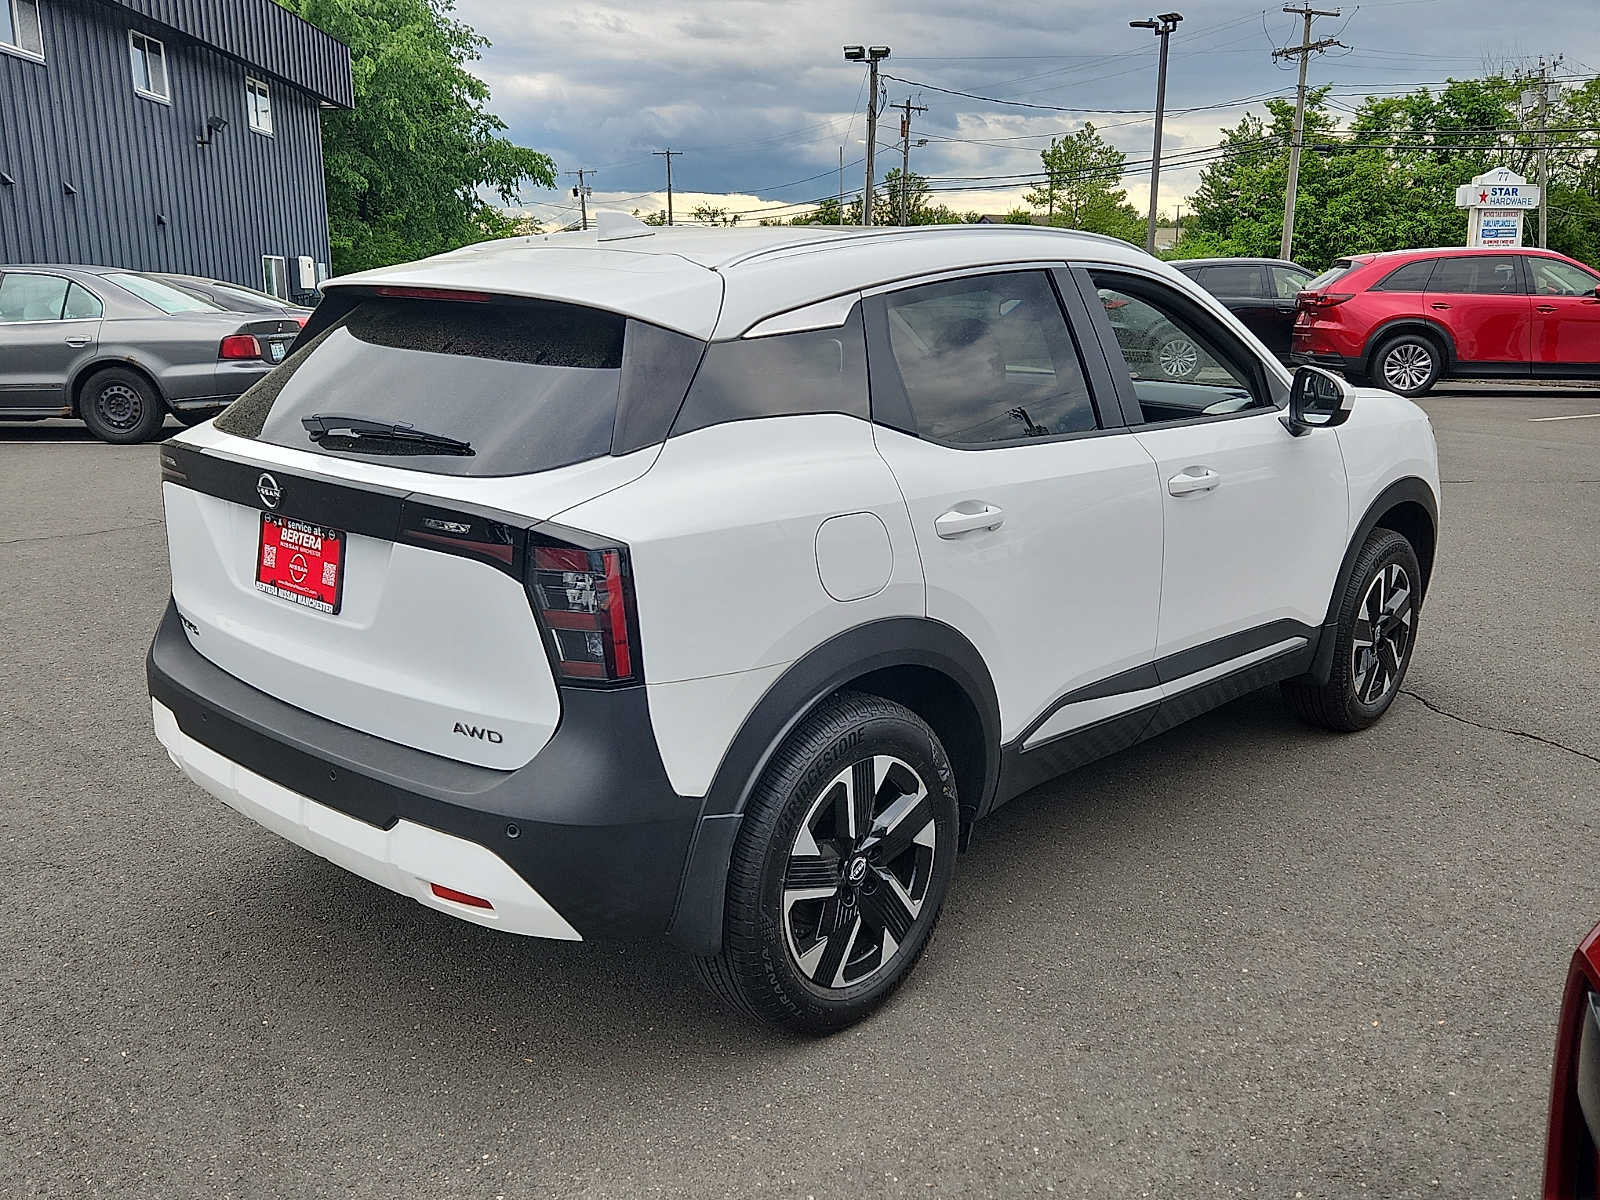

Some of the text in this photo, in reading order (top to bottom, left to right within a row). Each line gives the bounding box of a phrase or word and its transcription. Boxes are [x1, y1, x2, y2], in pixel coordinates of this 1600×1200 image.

[1498, 171, 1510, 182] 77
[1491, 187, 1519, 197] STAR
[1489, 197, 1533, 206] HARDWARE
[287, 520, 312, 534] service
[280, 527, 322, 551] BERTERA
[297, 594, 333, 614] MANCHESTER
[453, 722, 503, 744] AWD
